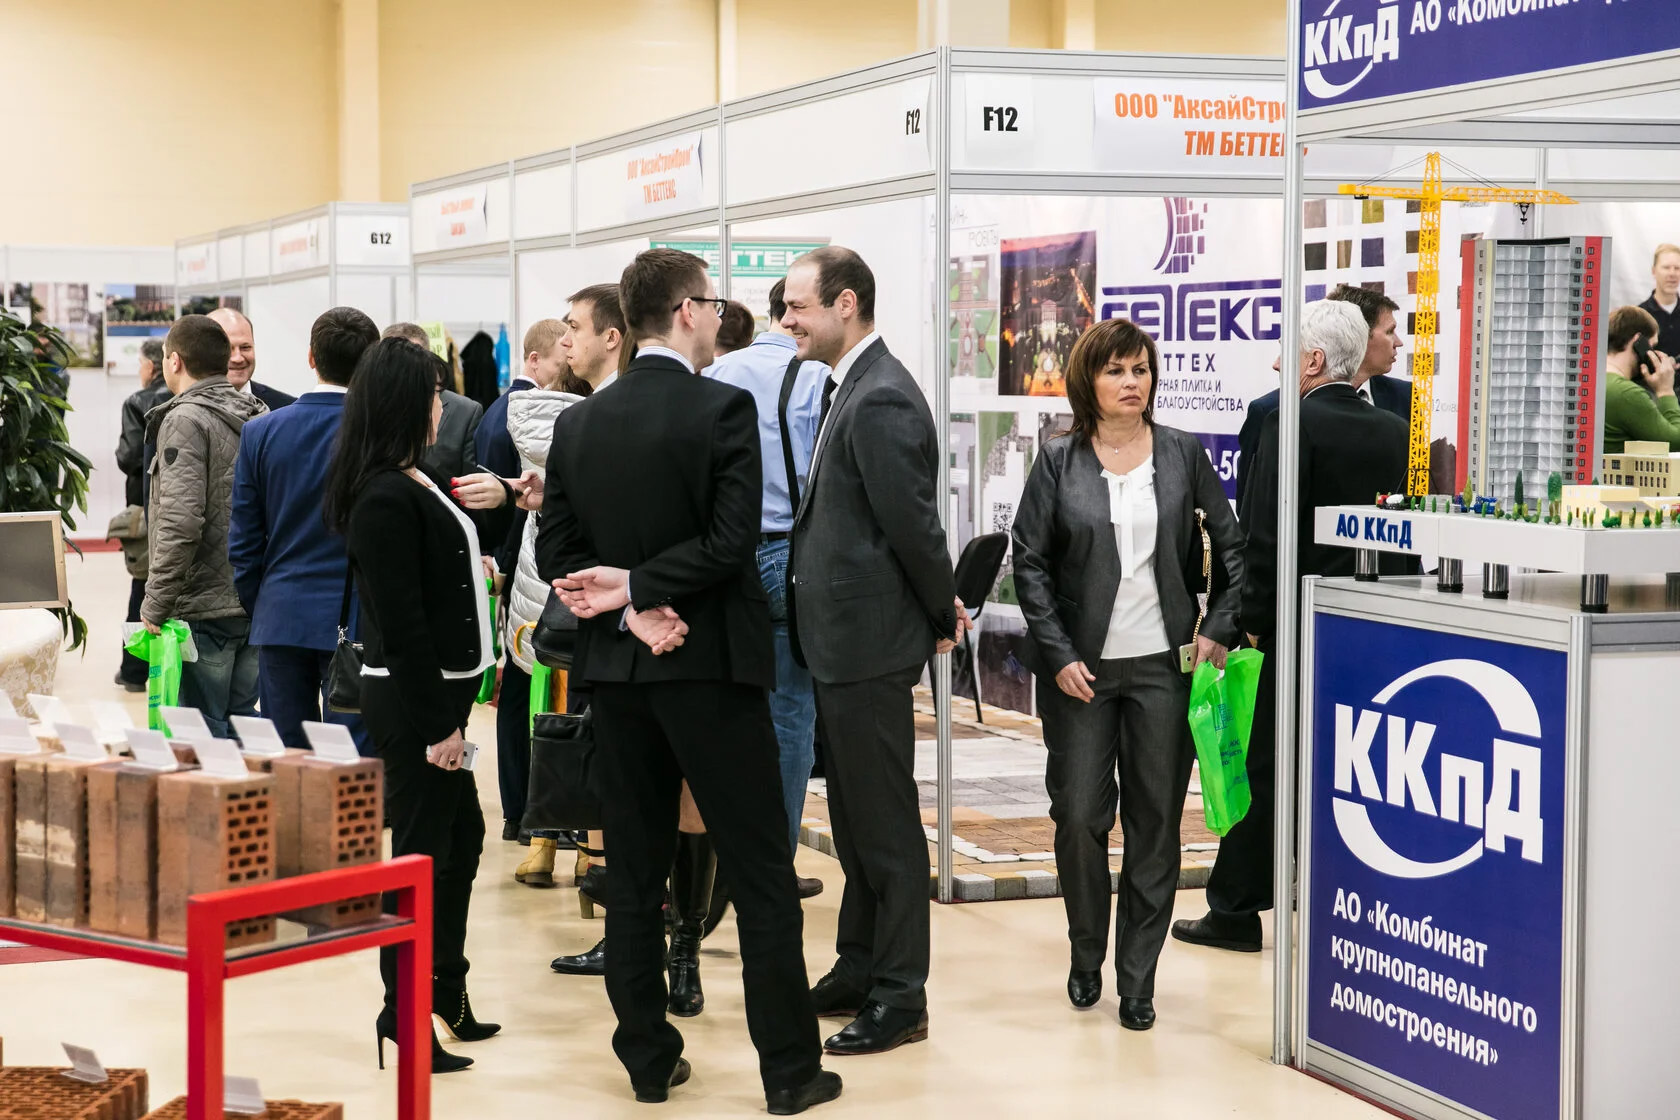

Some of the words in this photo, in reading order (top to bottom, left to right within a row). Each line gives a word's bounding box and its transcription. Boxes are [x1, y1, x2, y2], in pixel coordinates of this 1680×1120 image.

[1409, 0, 1442, 35] АО
[1447, 0, 1578, 26] «Комби
[1304, 4, 1399, 68] ККпД
[905, 108, 921, 136] F12
[983, 106, 1019, 132] F12
[1114, 92, 1158, 118] ООО
[1162, 92, 1286, 123] "АксайСтр
[1184, 130, 1215, 156] ТМ
[1219, 131, 1287, 157] БЕТТЕ
[370, 232, 392, 245] G12
[1157, 378, 1179, 392] РНАЯ
[1181, 379, 1212, 393] ПЛИТКА
[1215, 380, 1222, 393] И
[1157, 394, 1245, 412] БЛАГОУСТРОЙСТВА
[1335, 512, 1360, 539] АО
[1364, 516, 1413, 550] ККпД
[1333, 702, 1544, 865] ККпД
[1332, 886, 1362, 924] АО
[1367, 900, 1488, 969] «Комбинат
[1331, 934, 1538, 1034] крупнопанельного
[1330, 982, 1500, 1067] домостроения»
